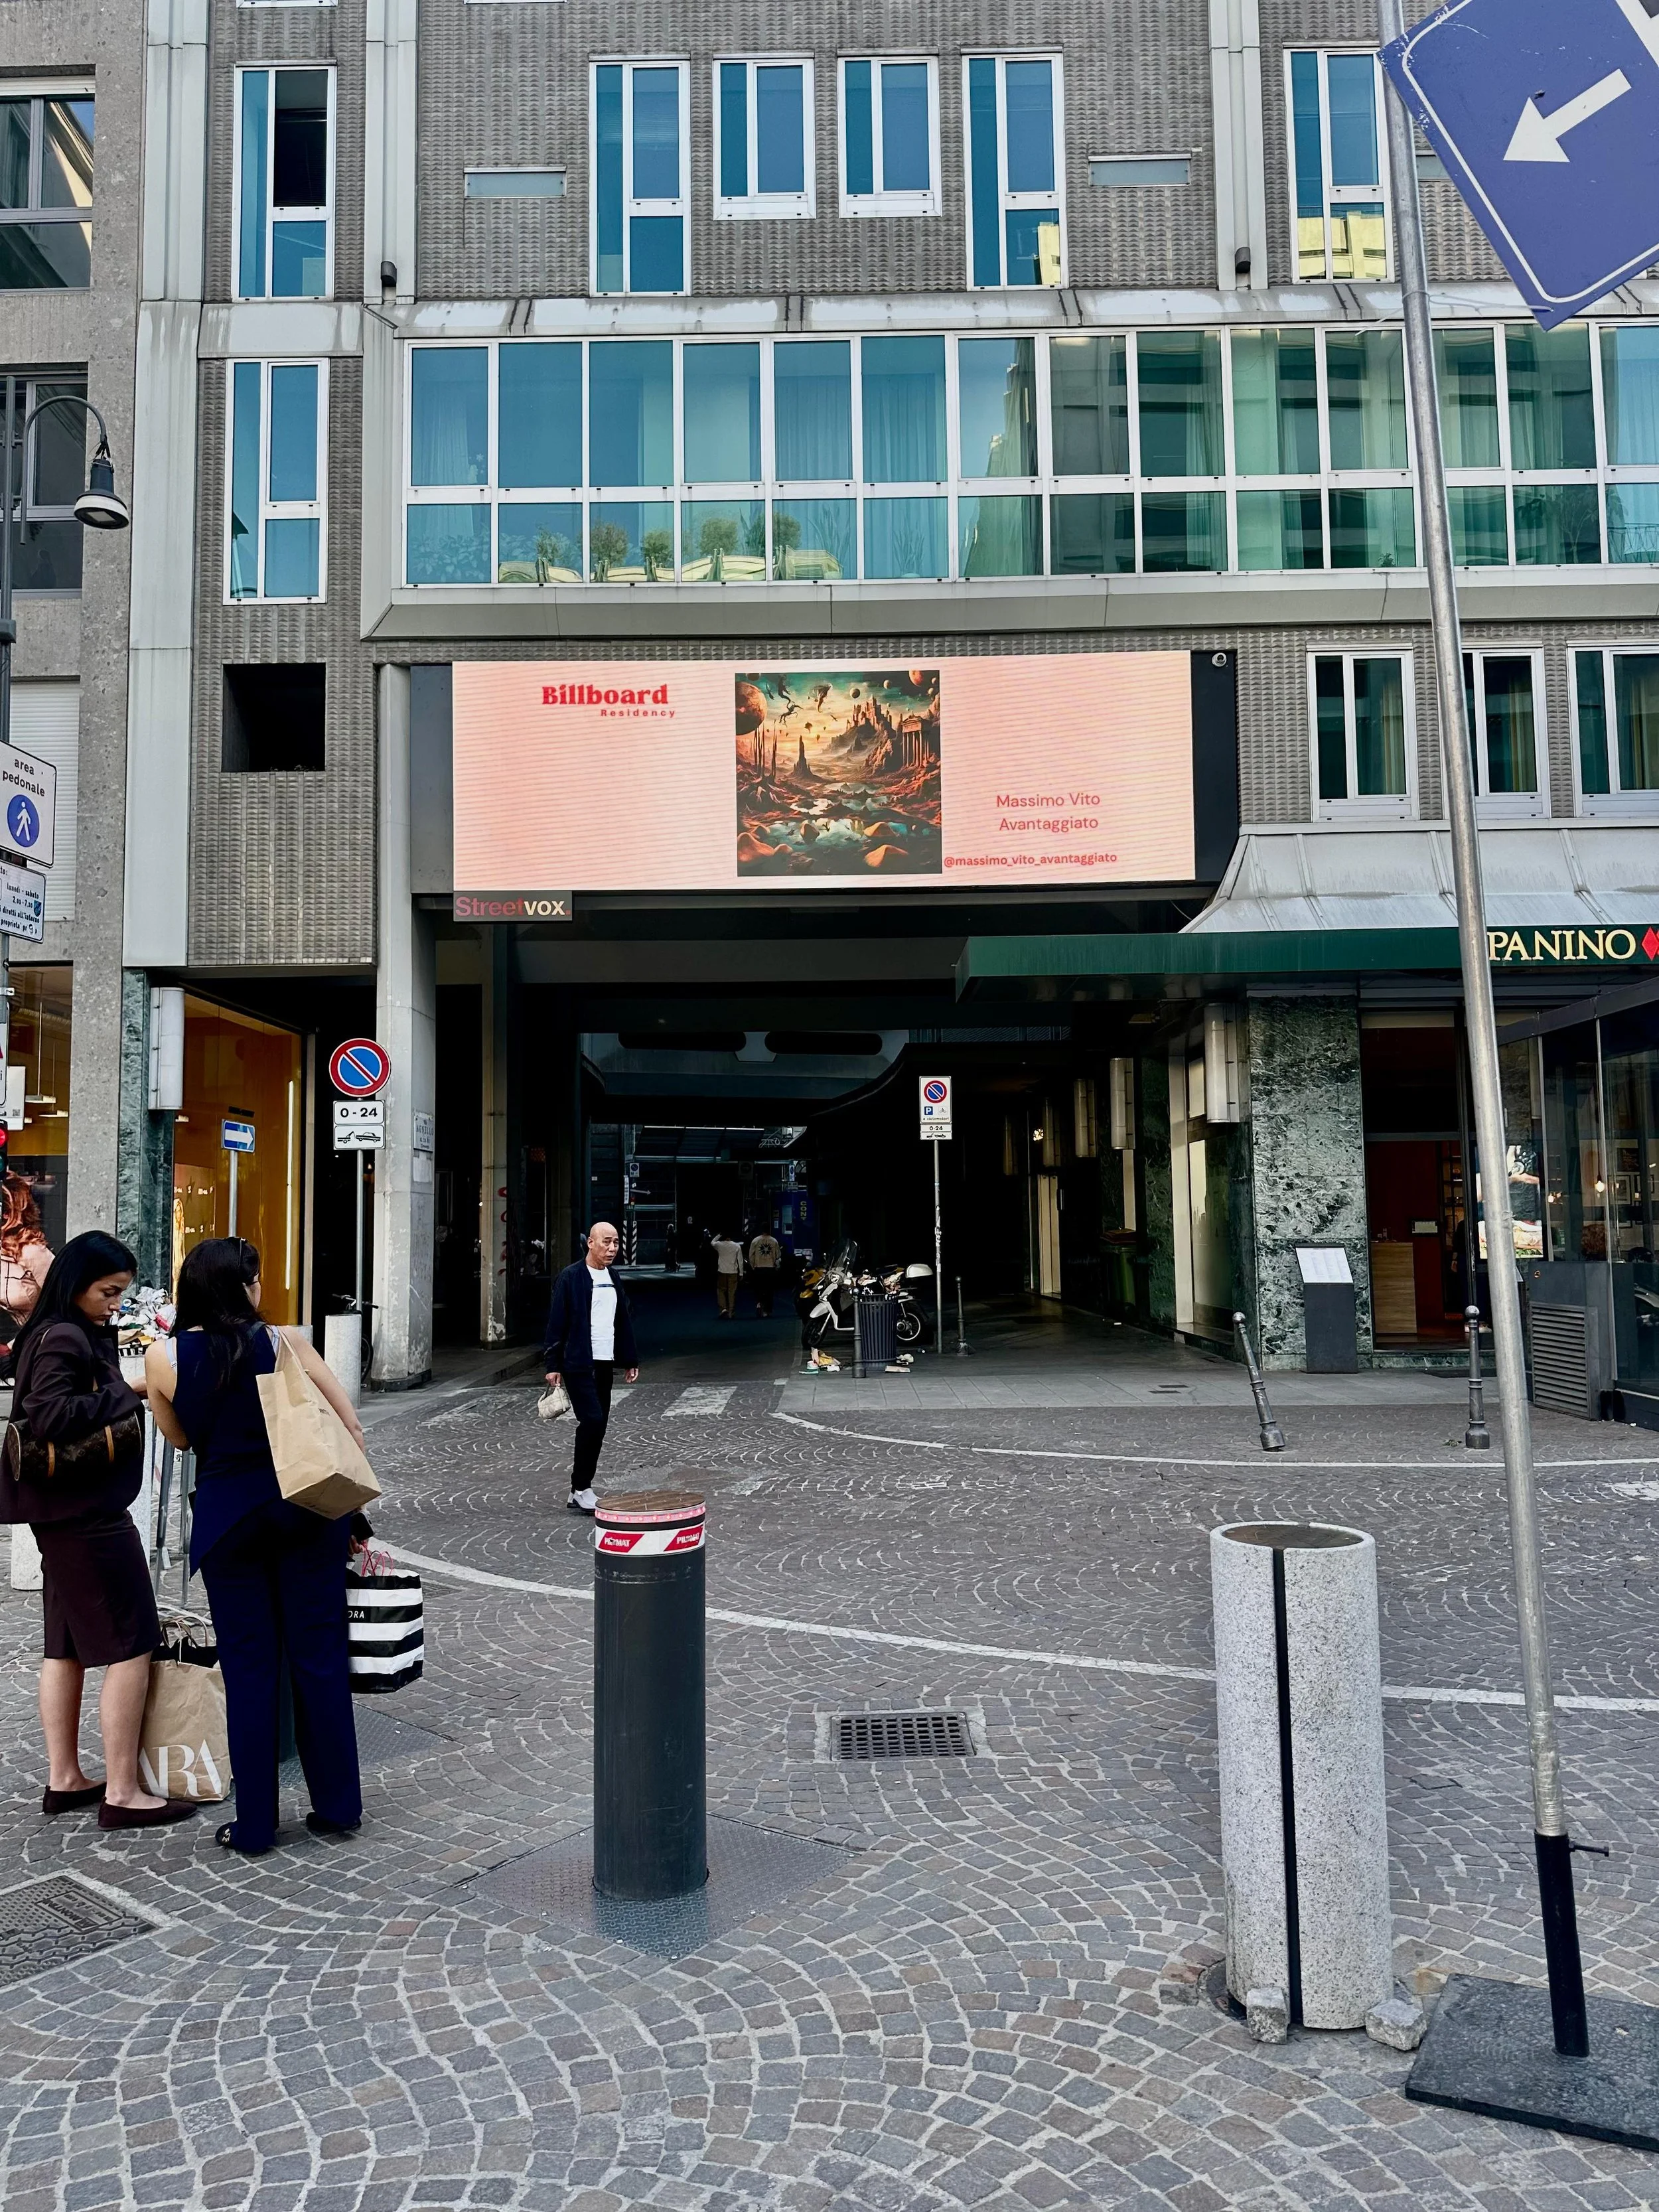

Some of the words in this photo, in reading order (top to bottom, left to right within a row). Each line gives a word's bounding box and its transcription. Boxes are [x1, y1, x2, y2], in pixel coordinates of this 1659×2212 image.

[542, 684, 668, 704] Billboard
[600, 709, 676, 718] Residency
[14, 759, 35, 775] area
[3, 770, 45, 796] pedonale
[997, 794, 1064, 808] Massimo
[1069, 792, 1100, 806] Vito
[999, 816, 1099, 833] Avantaggiato
[944, 852, 1118, 868] @massimo_vito_avantaggiato
[25, 889, 39, 899] sabato
[455, 896, 571, 917] Streetvox.
[1486, 928, 1636, 961] PANINO
[340, 1108, 349, 1118] 0
[360, 1107, 378, 1118] 24
